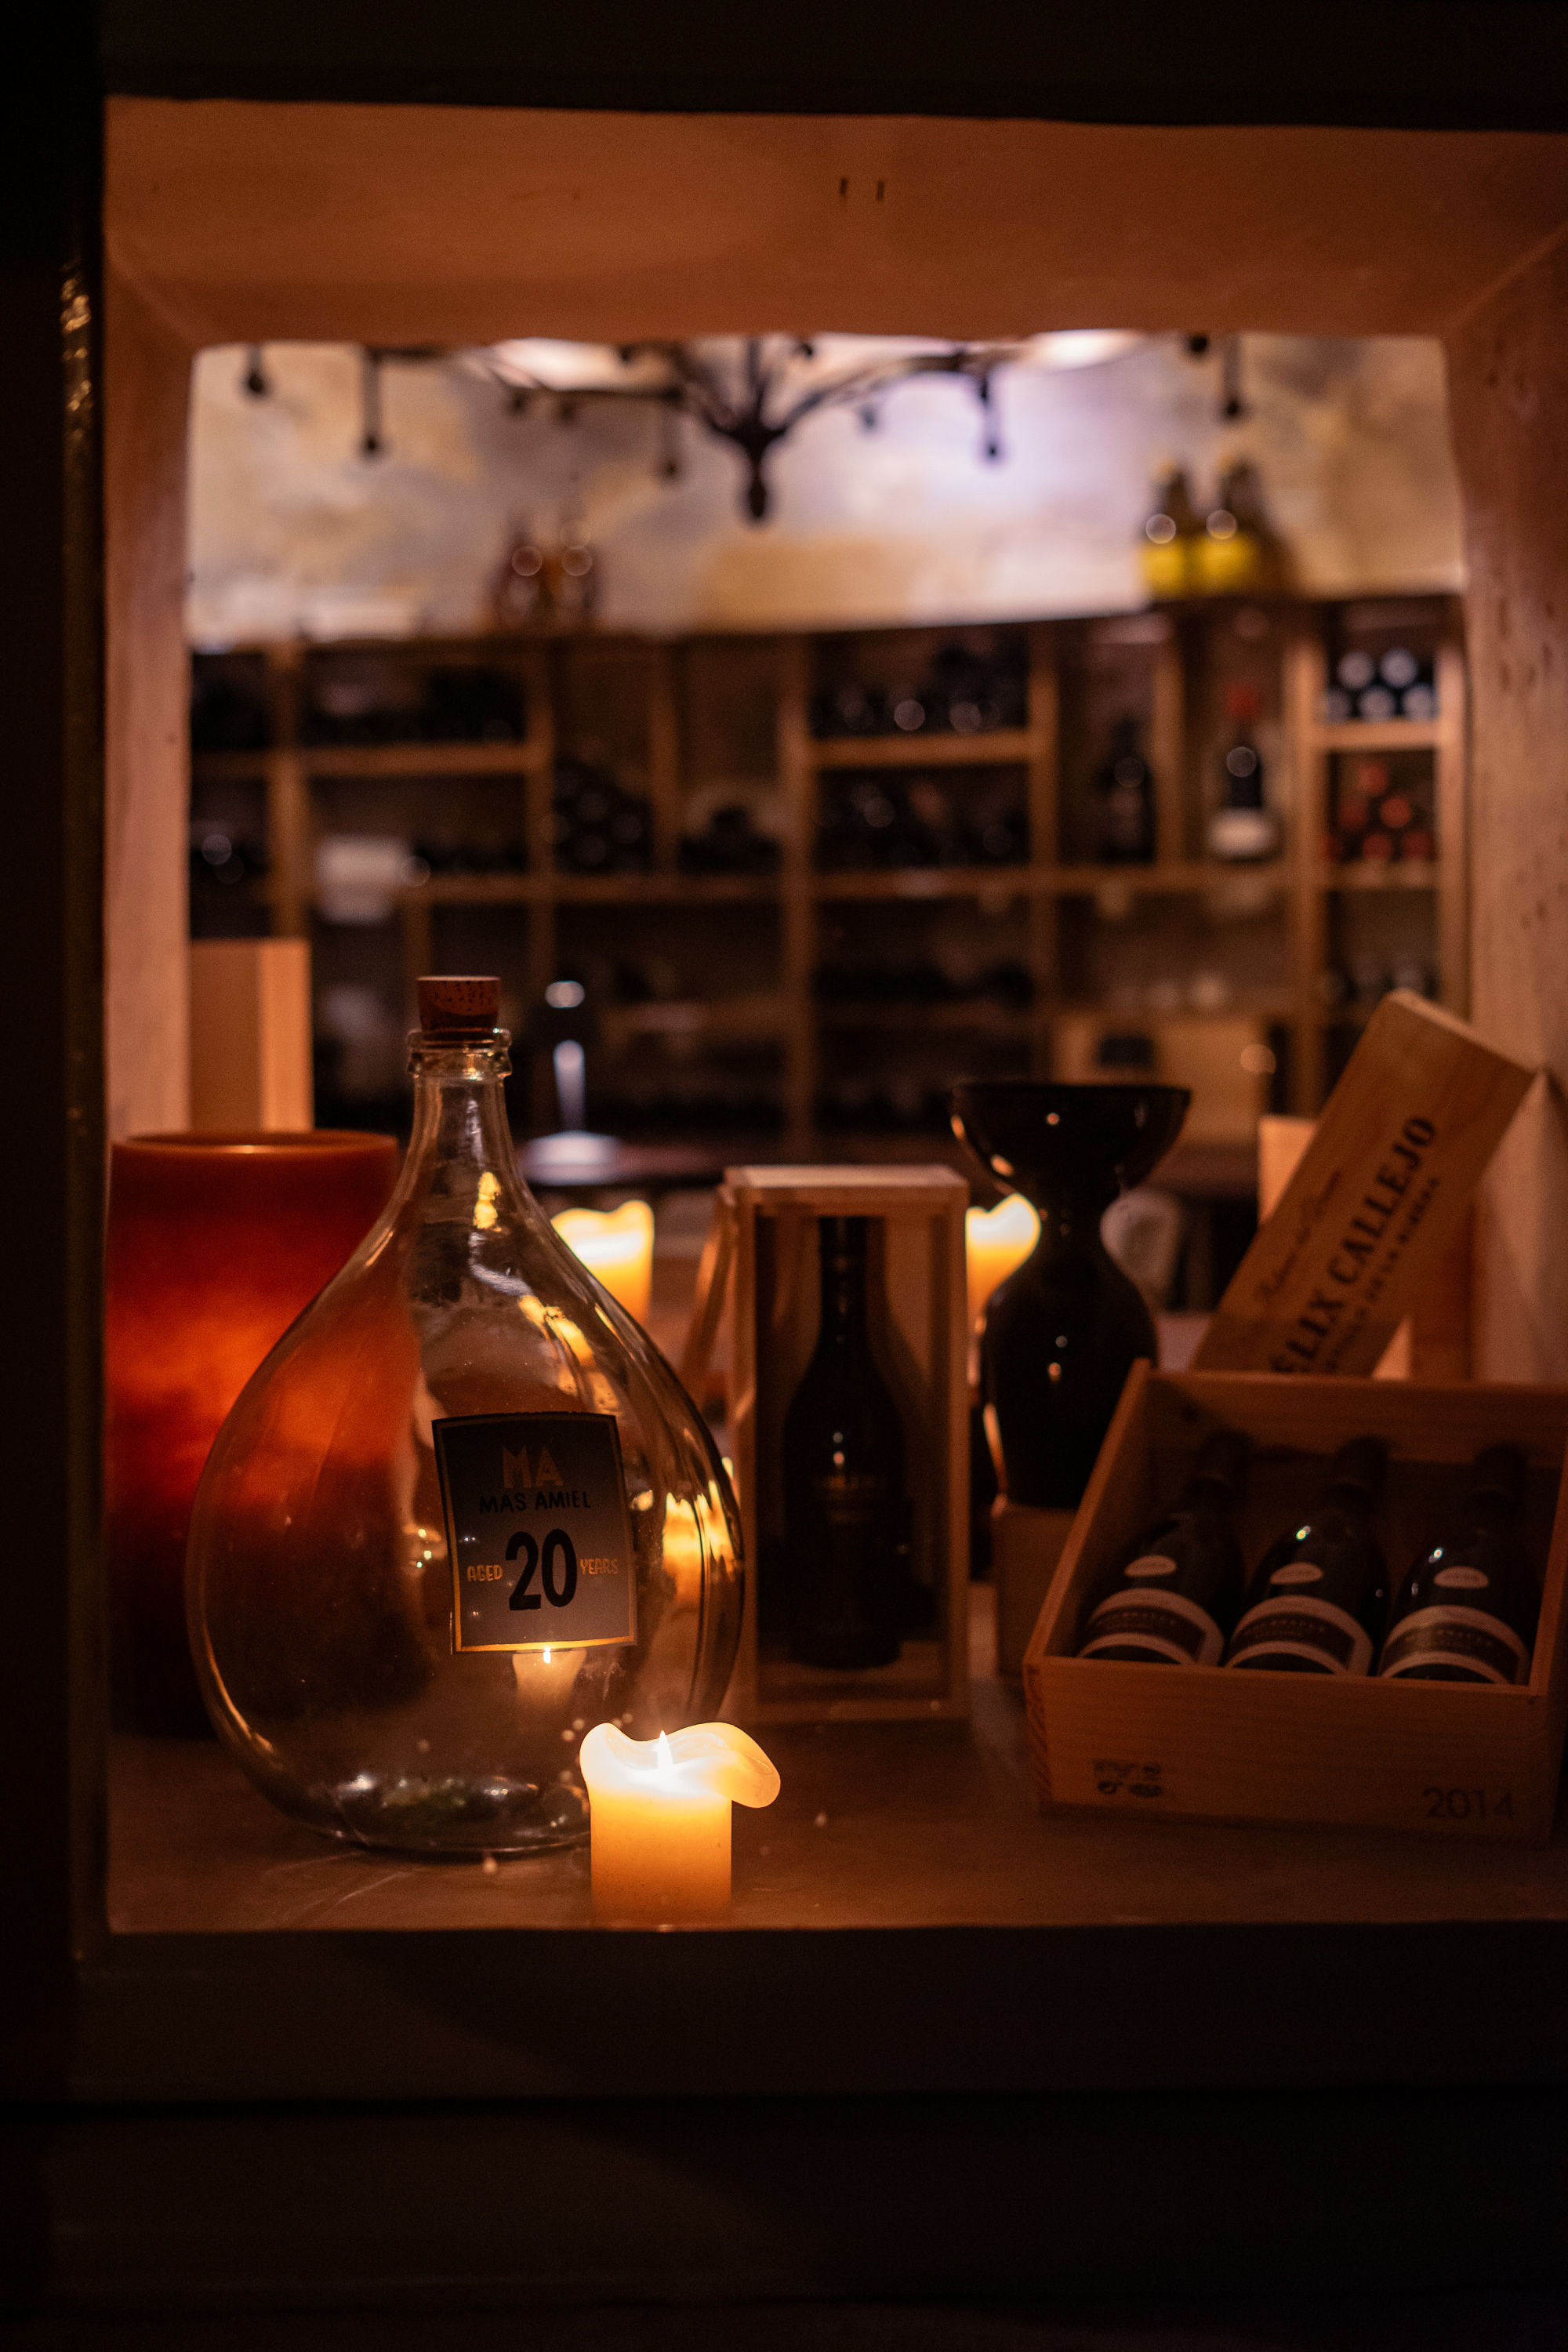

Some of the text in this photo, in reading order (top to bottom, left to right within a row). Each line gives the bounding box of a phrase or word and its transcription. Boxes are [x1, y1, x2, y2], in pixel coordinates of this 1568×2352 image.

[1327, 1117, 1435, 1284] CALLEJO
[503, 1444, 564, 1489] MA
[479, 1491, 591, 1514] MAS AMIEL
[466, 1529, 619, 1610] AGED 20 YEARS
[1422, 1788, 1515, 1820] 2014
